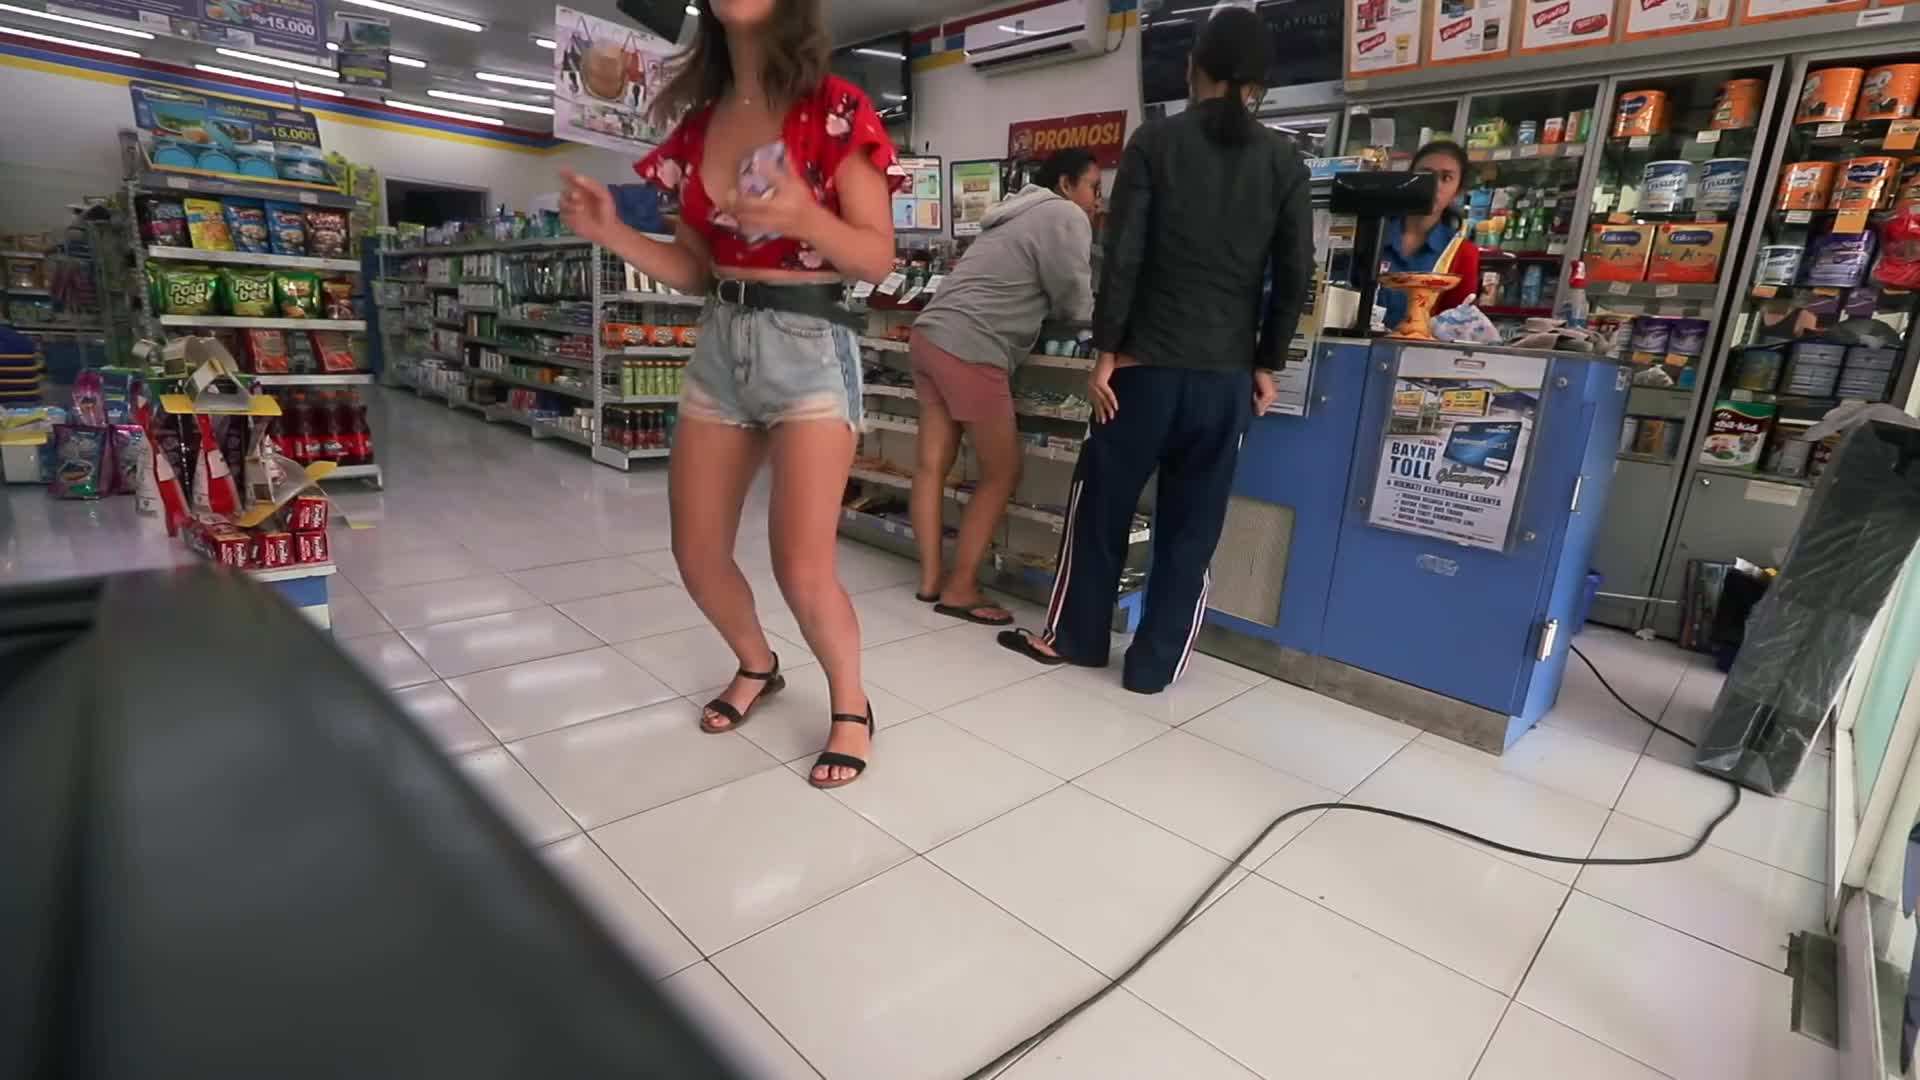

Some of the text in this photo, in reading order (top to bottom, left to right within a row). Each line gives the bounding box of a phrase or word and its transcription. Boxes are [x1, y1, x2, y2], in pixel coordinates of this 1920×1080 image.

[1034, 121, 1121, 151] PROMOS!
[1391, 441, 1437, 462] BAYAR
[1390, 455, 1432, 481] TOLL
